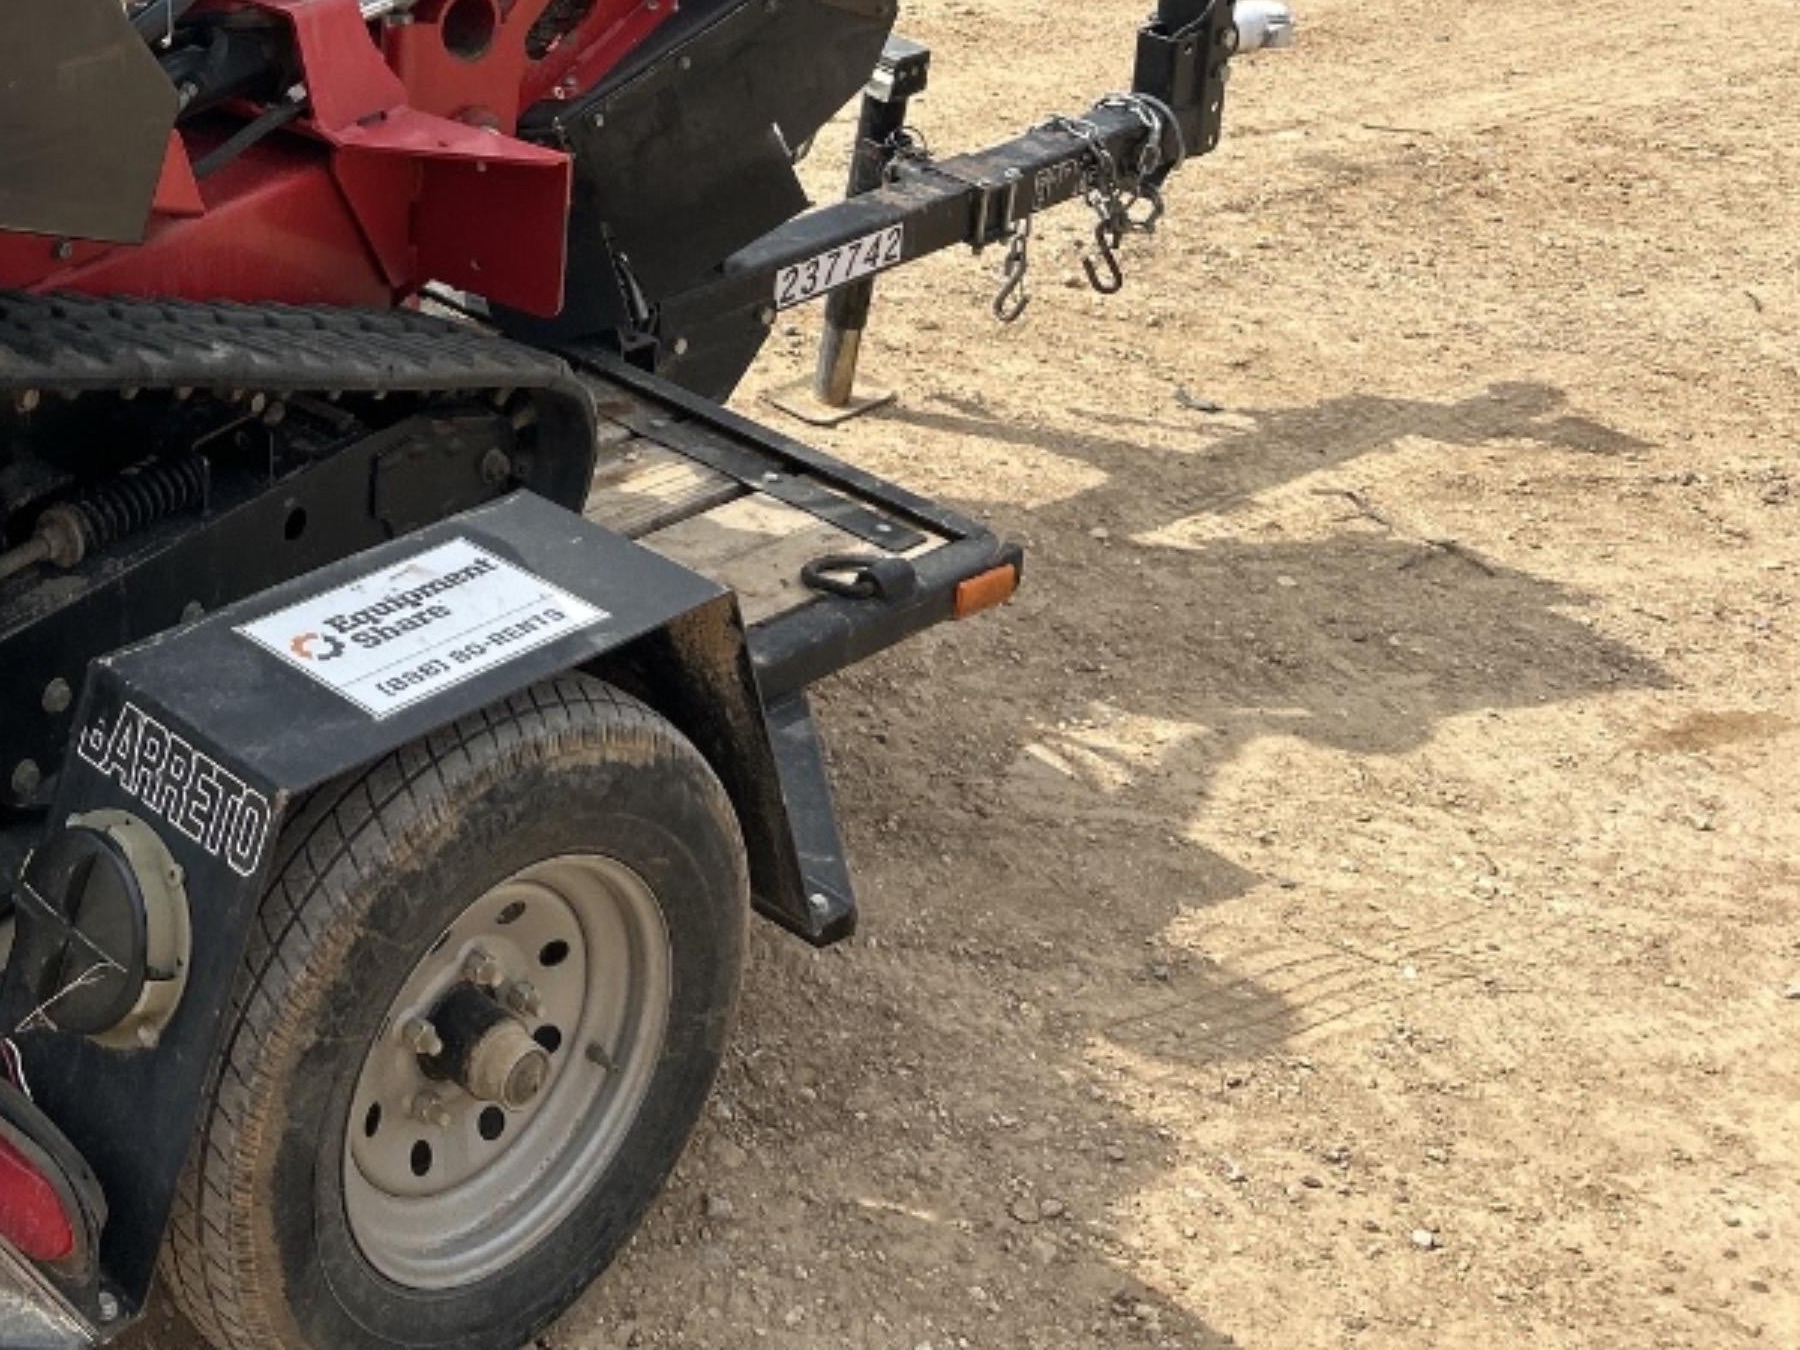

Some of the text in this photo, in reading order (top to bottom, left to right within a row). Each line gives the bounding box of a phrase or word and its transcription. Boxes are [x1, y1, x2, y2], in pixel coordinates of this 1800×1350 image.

[779, 227, 901, 305] 237742
[323, 556, 499, 636] Equipment
[350, 599, 452, 650] Share
